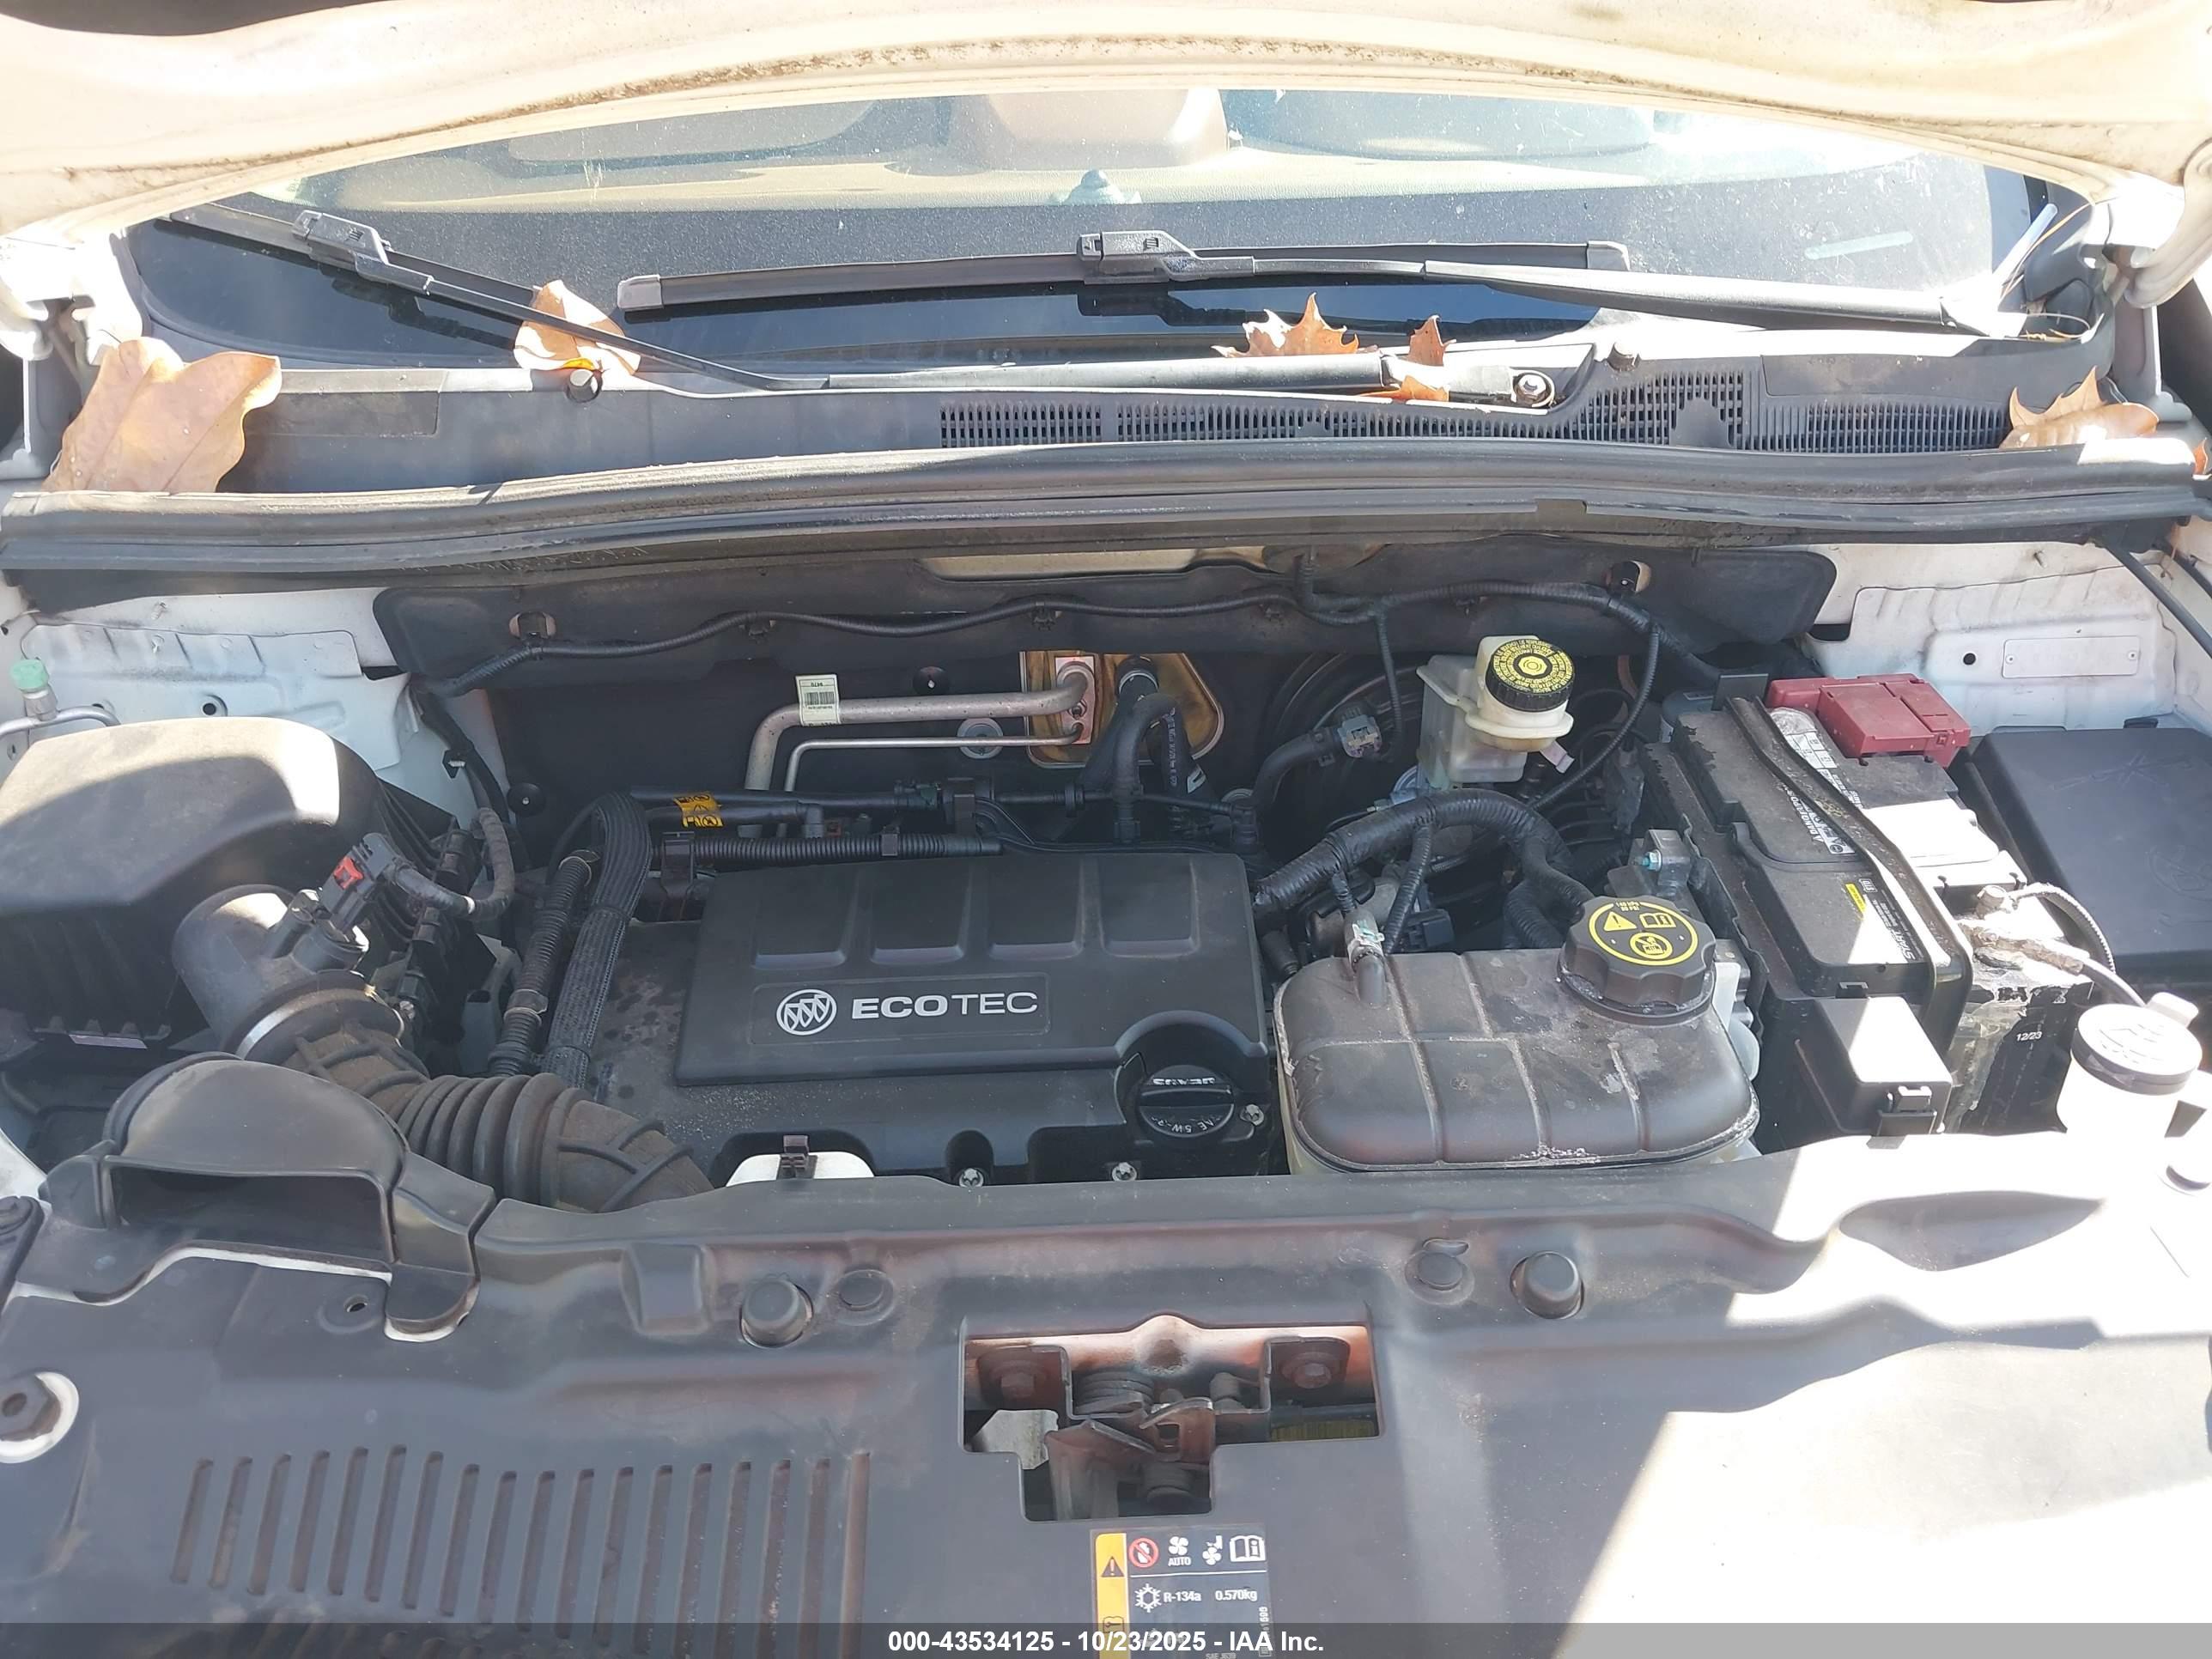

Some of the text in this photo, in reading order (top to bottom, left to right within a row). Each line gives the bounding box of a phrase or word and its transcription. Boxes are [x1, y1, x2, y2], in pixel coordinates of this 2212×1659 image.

[852, 992, 1038, 1019] ECOTEC
[2016, 1030, 2043, 1042] 12/23
[1168, 1556, 1192, 1566] AUTO
[1164, 1589, 1258, 1602] R-134a 0.570kg
